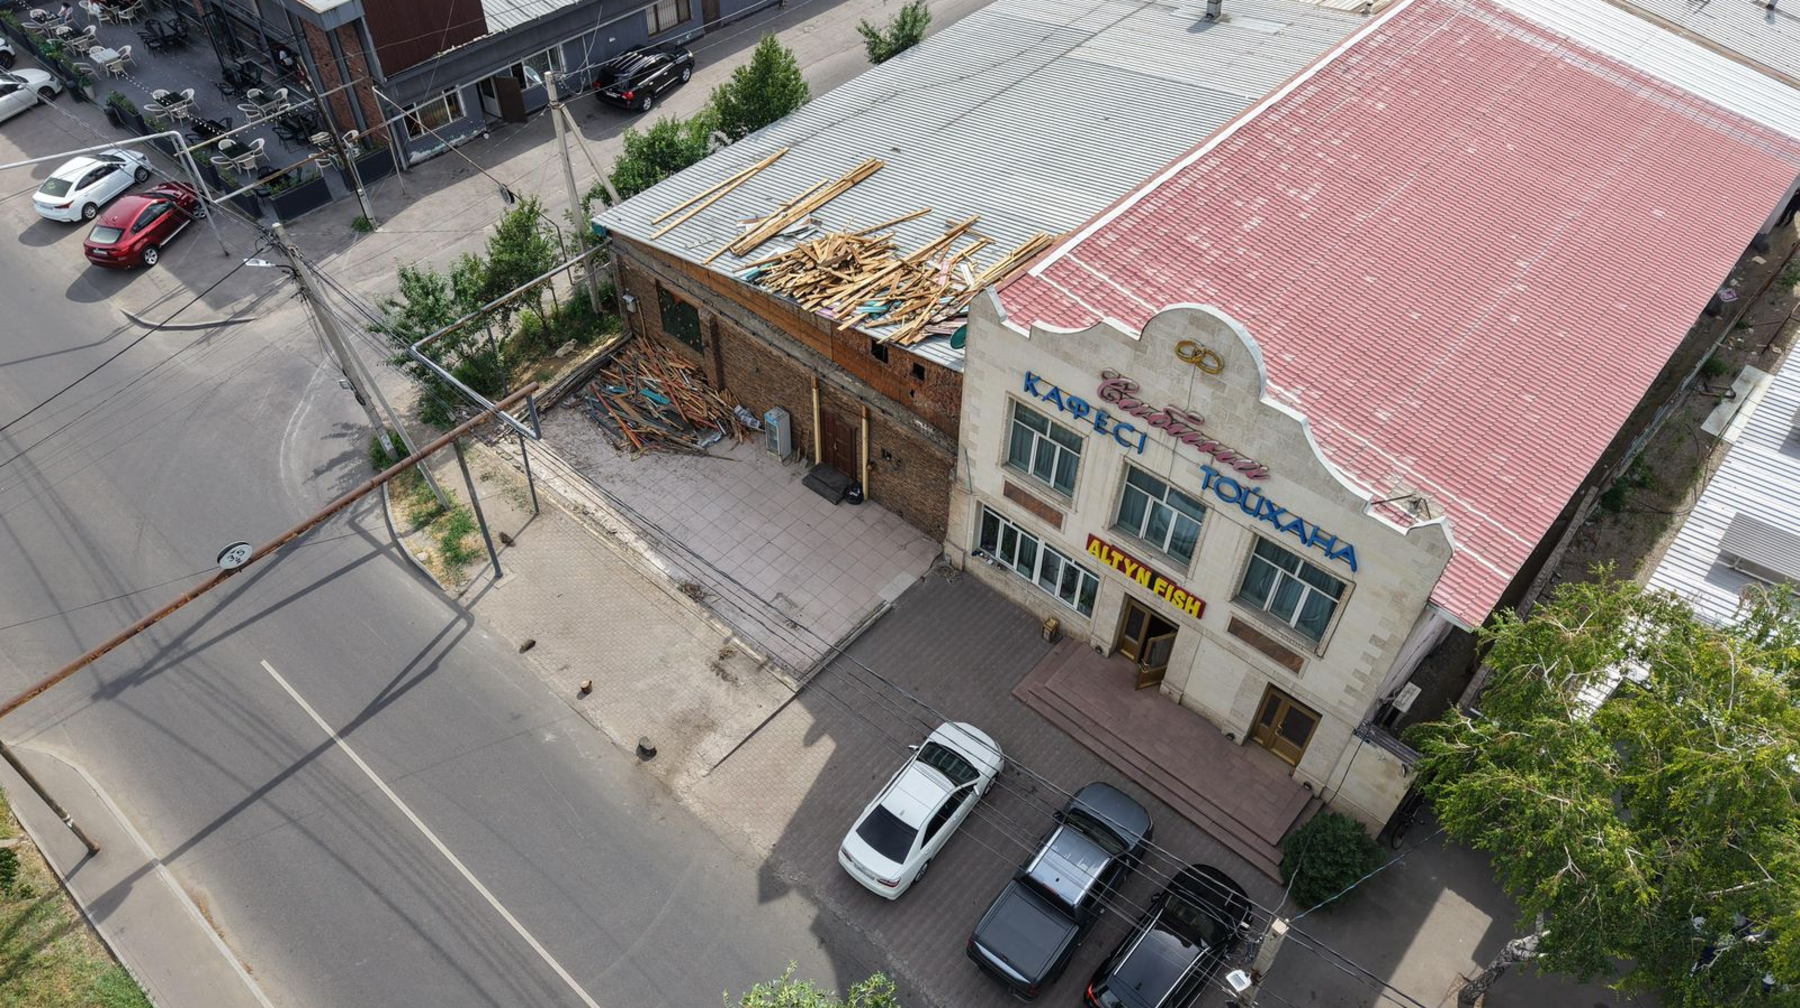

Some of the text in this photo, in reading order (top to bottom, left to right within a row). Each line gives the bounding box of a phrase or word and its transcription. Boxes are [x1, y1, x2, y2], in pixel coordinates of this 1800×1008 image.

[1024, 370, 1147, 454] КАФЕСІ
[1097, 369, 1271, 480] Сабина
[1201, 464, 1357, 572] ТОЙХАНА
[1087, 539, 1202, 619] ALTYN FISH
